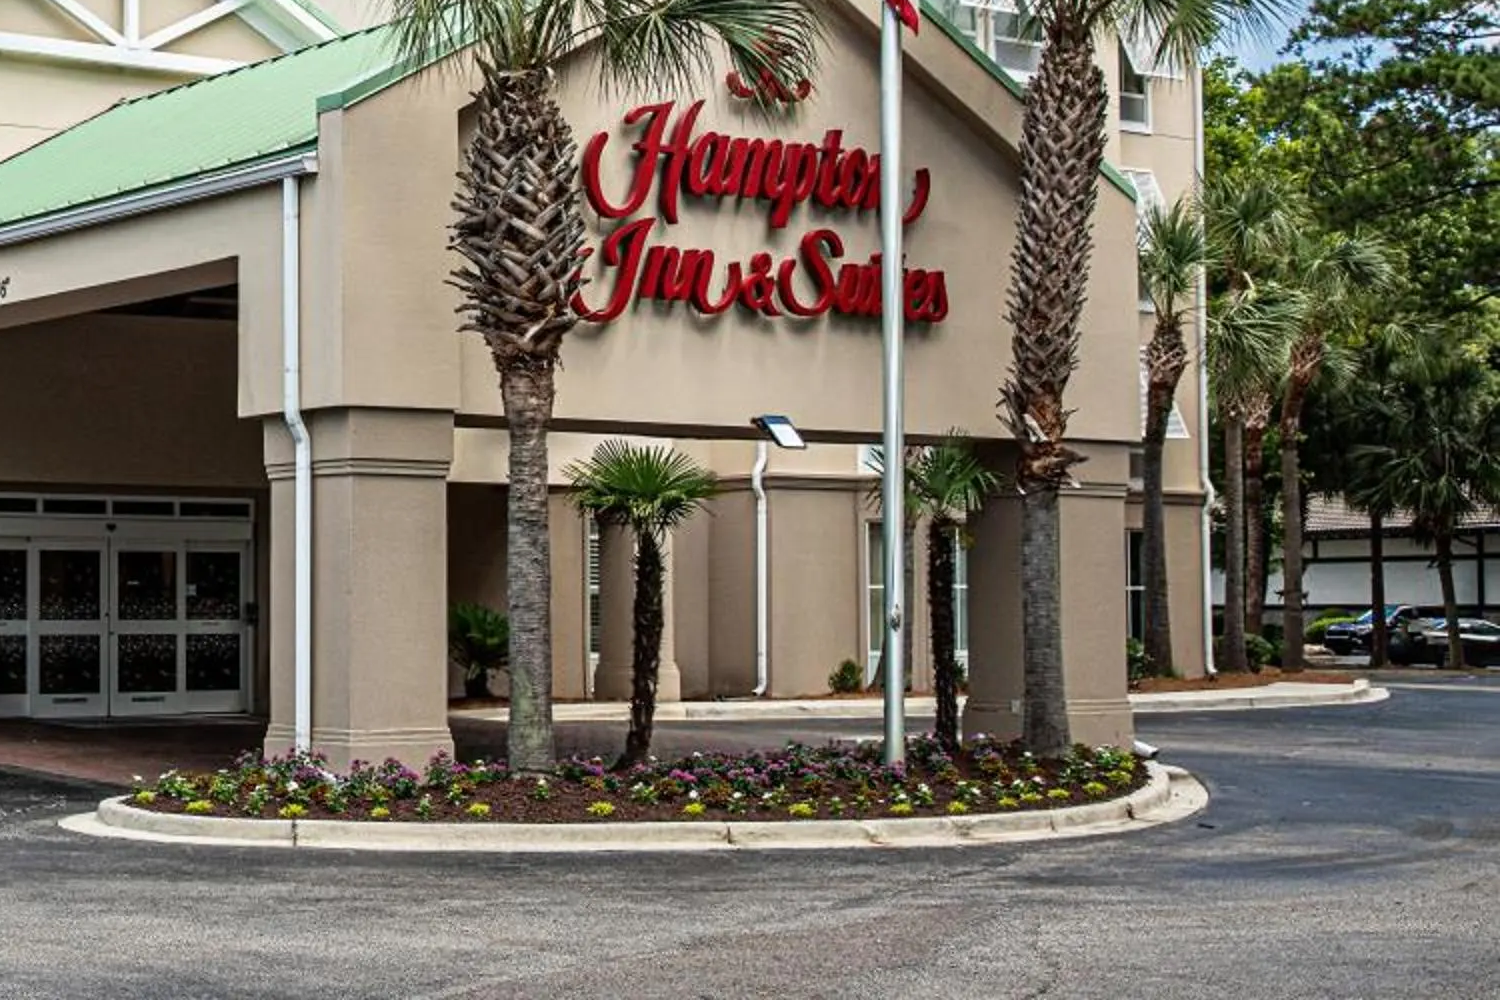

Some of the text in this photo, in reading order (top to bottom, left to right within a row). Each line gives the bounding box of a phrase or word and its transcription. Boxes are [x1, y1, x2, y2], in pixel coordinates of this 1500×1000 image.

[570, 217, 949, 323] Inn & Suies
